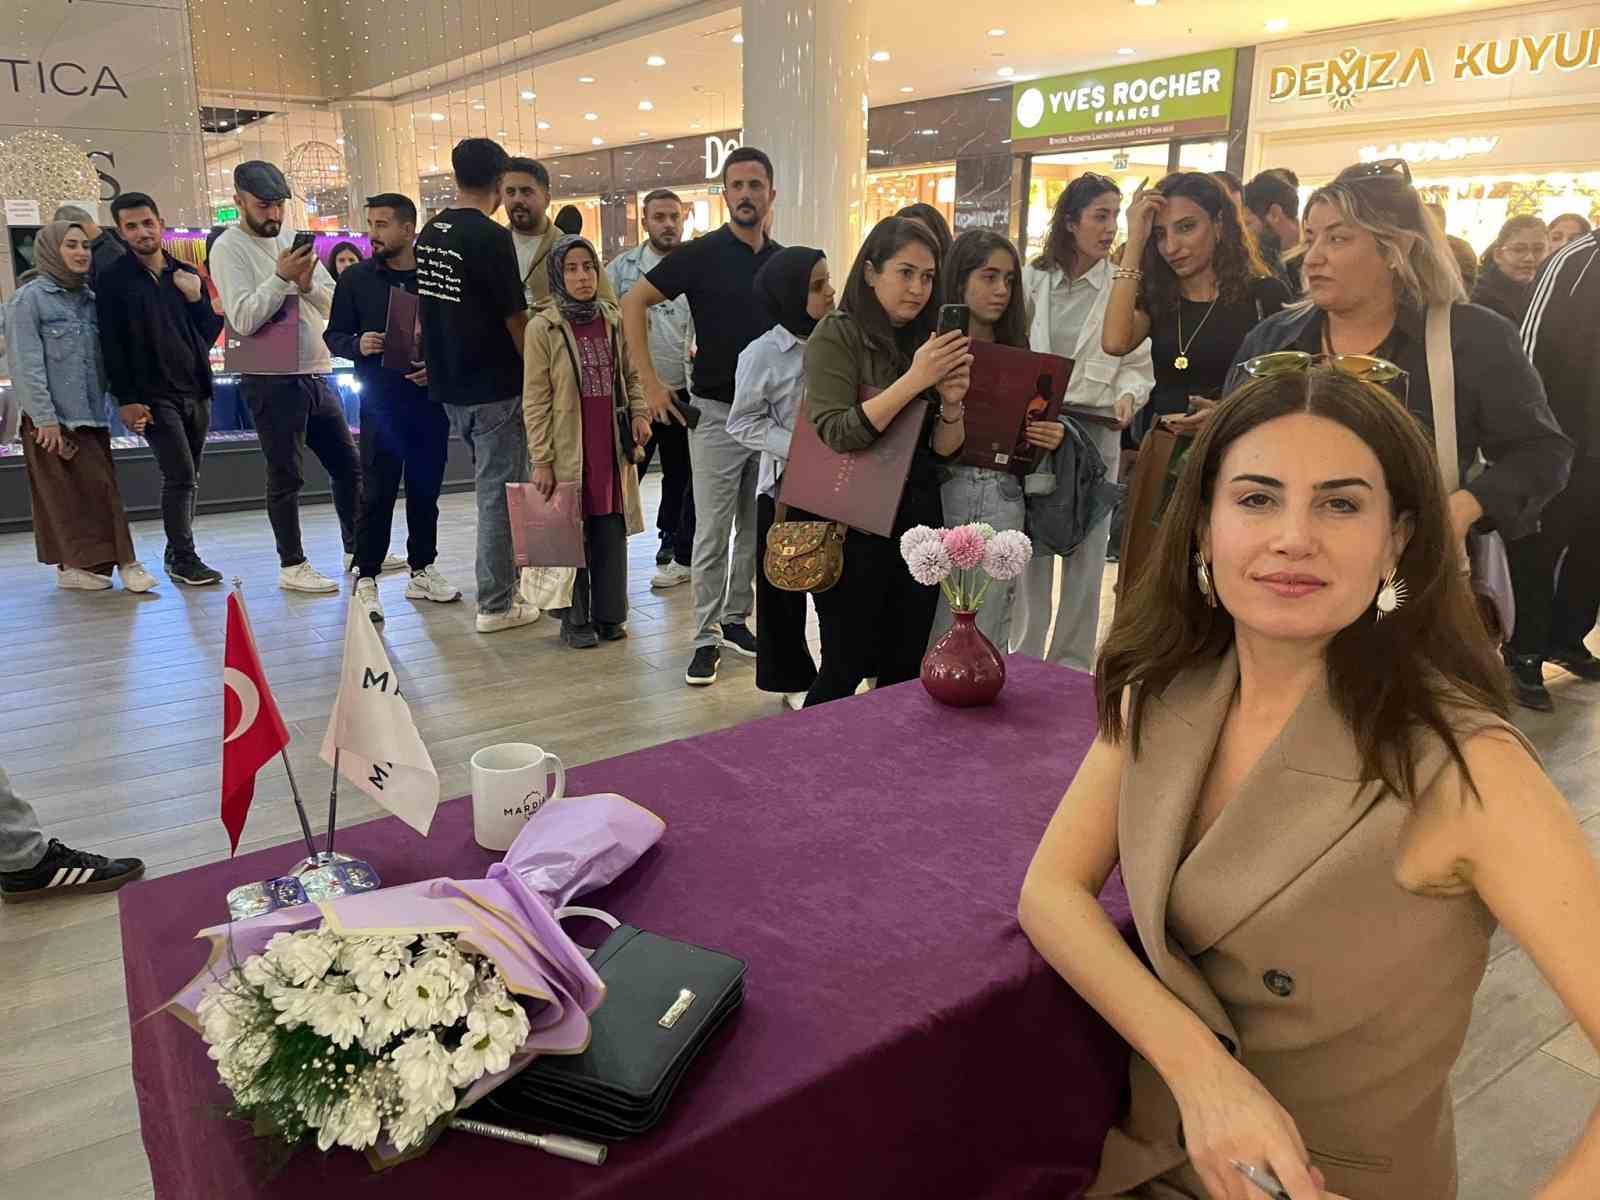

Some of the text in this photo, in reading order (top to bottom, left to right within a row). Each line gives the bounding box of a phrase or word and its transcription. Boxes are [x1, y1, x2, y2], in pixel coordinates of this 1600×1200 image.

[0, 58, 128, 98] TICA
[1049, 68, 1221, 114] YVES ROCHER
[1095, 104, 1161, 124] FRANCE
